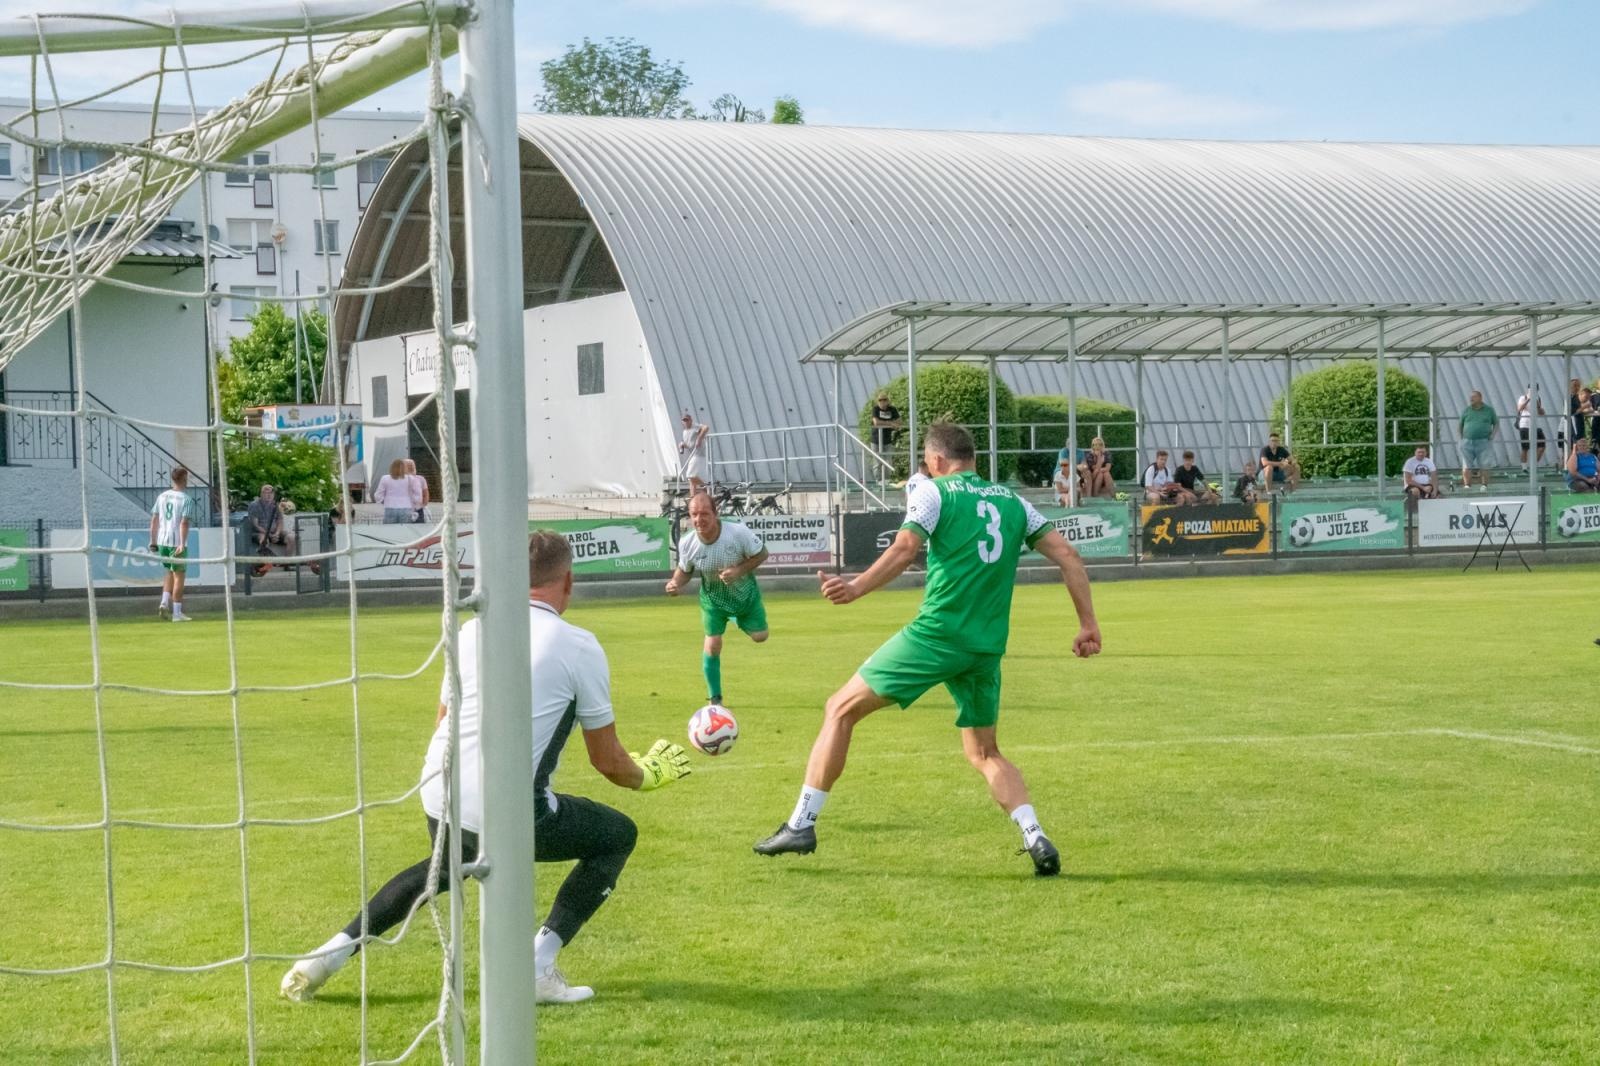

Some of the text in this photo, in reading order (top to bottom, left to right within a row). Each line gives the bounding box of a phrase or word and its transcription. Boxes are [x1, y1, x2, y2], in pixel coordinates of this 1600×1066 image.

[165, 502, 174, 520] 8
[1316, 512, 1348, 524] DANIEL
[743, 517, 825, 531] akiernictwo
[976, 500, 1003, 564] 3
[1176, 519, 1260, 535] #POZAMIATANE
[1327, 520, 1369, 537] JUZEK
[564, 531, 596, 544] AROL
